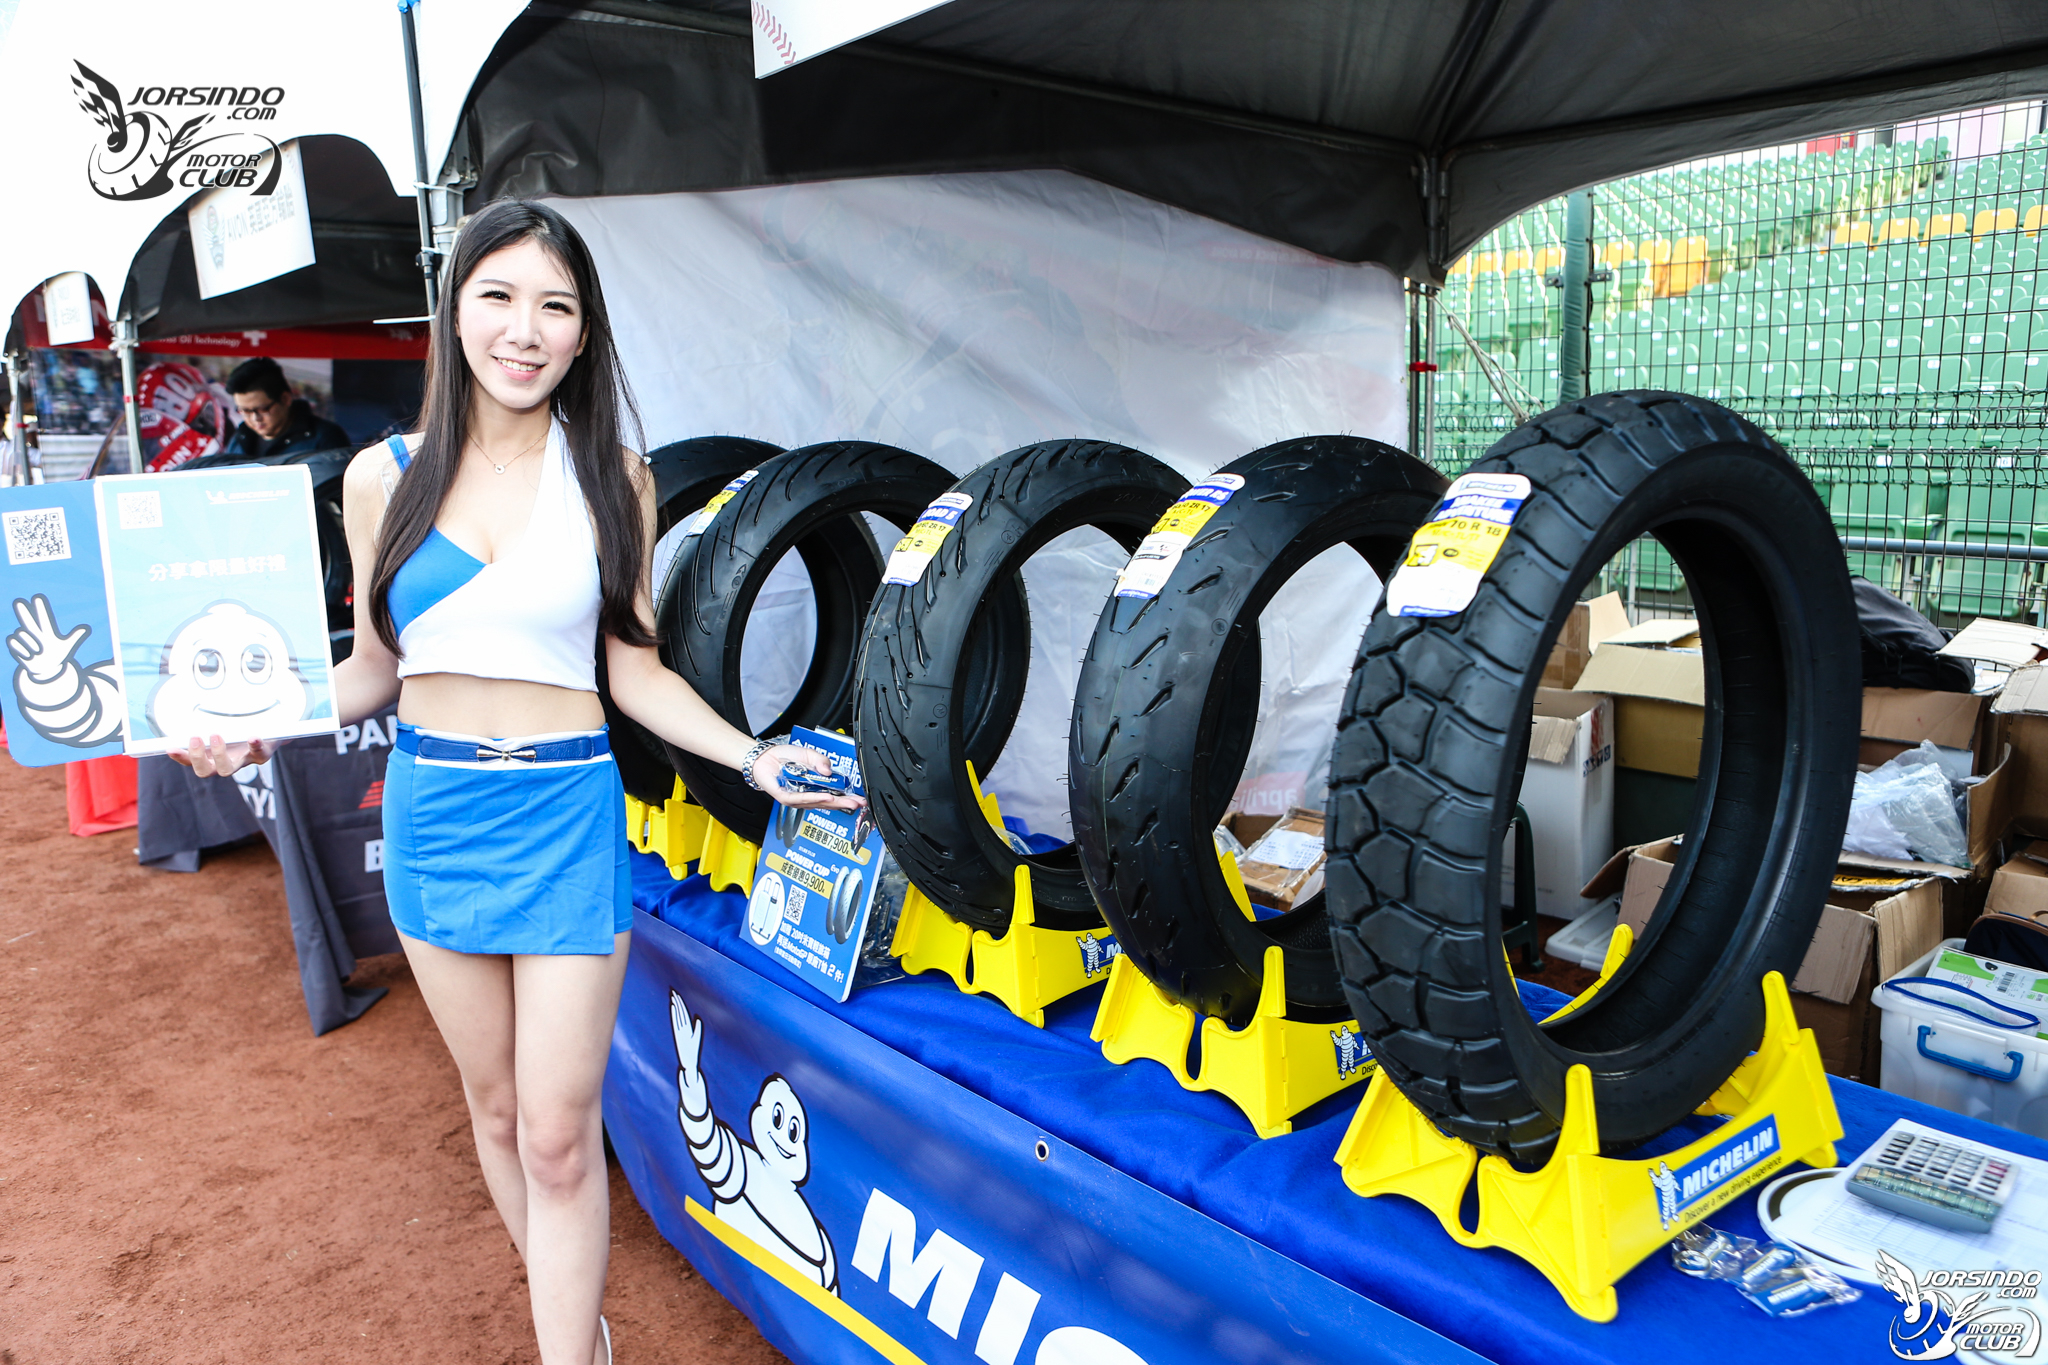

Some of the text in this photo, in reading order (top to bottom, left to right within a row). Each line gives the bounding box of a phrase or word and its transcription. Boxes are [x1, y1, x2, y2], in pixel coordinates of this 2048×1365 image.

[806, 812, 838, 833] POWER
[835, 822, 849, 838] RS
[785, 849, 815, 871] POWER
[813, 863, 830, 877] CUP
[827, 963, 836, 977] 2
[1682, 1126, 1774, 1199] MICHELIN
[1684, 1155, 1783, 1223] Discover a new driving experience
